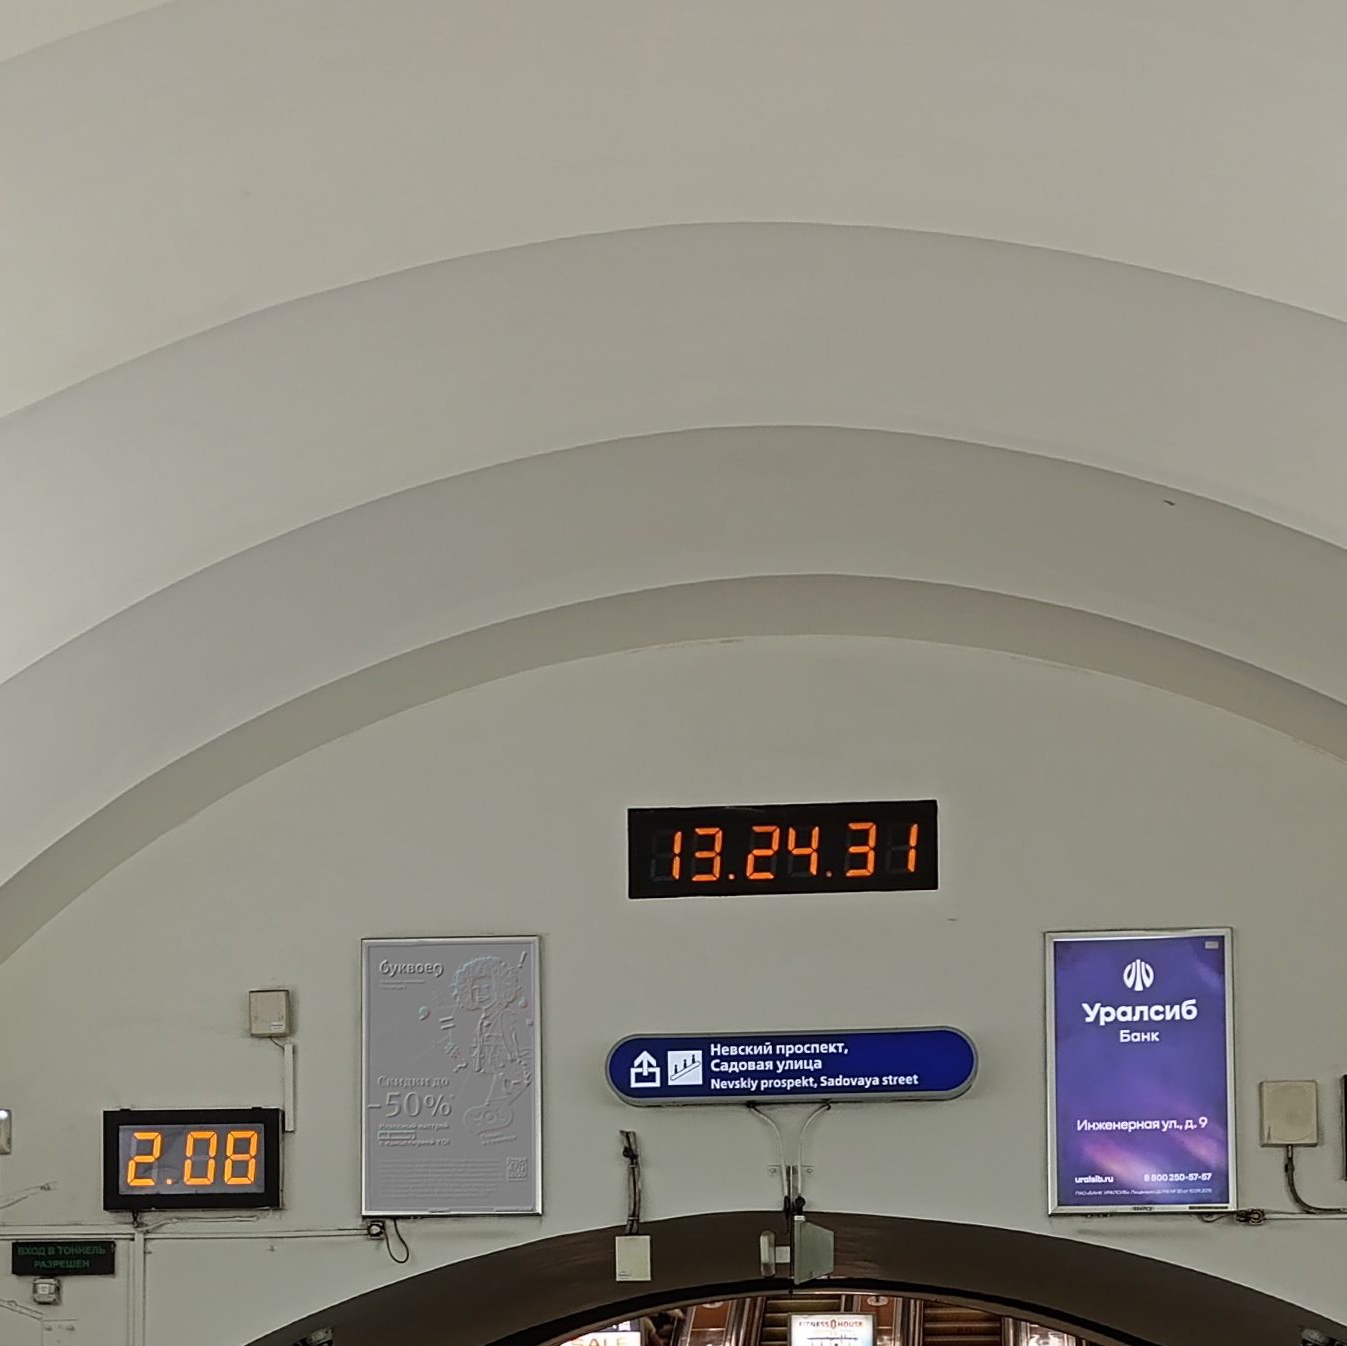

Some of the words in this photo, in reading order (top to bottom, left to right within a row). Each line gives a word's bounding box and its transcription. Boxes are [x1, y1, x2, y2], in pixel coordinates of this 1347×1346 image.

[670, 822, 920, 882] 13.24.31
[1082, 999, 1198, 1026] Уралсиб
[1120, 1029, 1160, 1042] Банк
[710, 1042, 773, 1056] Невский
[776, 1042, 849, 1057] проспект,
[710, 1059, 774, 1073] Садовая
[776, 1058, 822, 1073] улица
[710, 1077, 758, 1091] Nevskiy
[760, 1076, 818, 1091] prospekt,
[820, 1075, 880, 1088] Sadovaya
[882, 1074, 919, 1085] street
[1076, 1119, 1160, 1132] Инженерная
[1198, 1116, 1208, 1129] 9
[127, 1130, 259, 1186] 2.08
[17, 1246, 46, 1256] ВХОД
